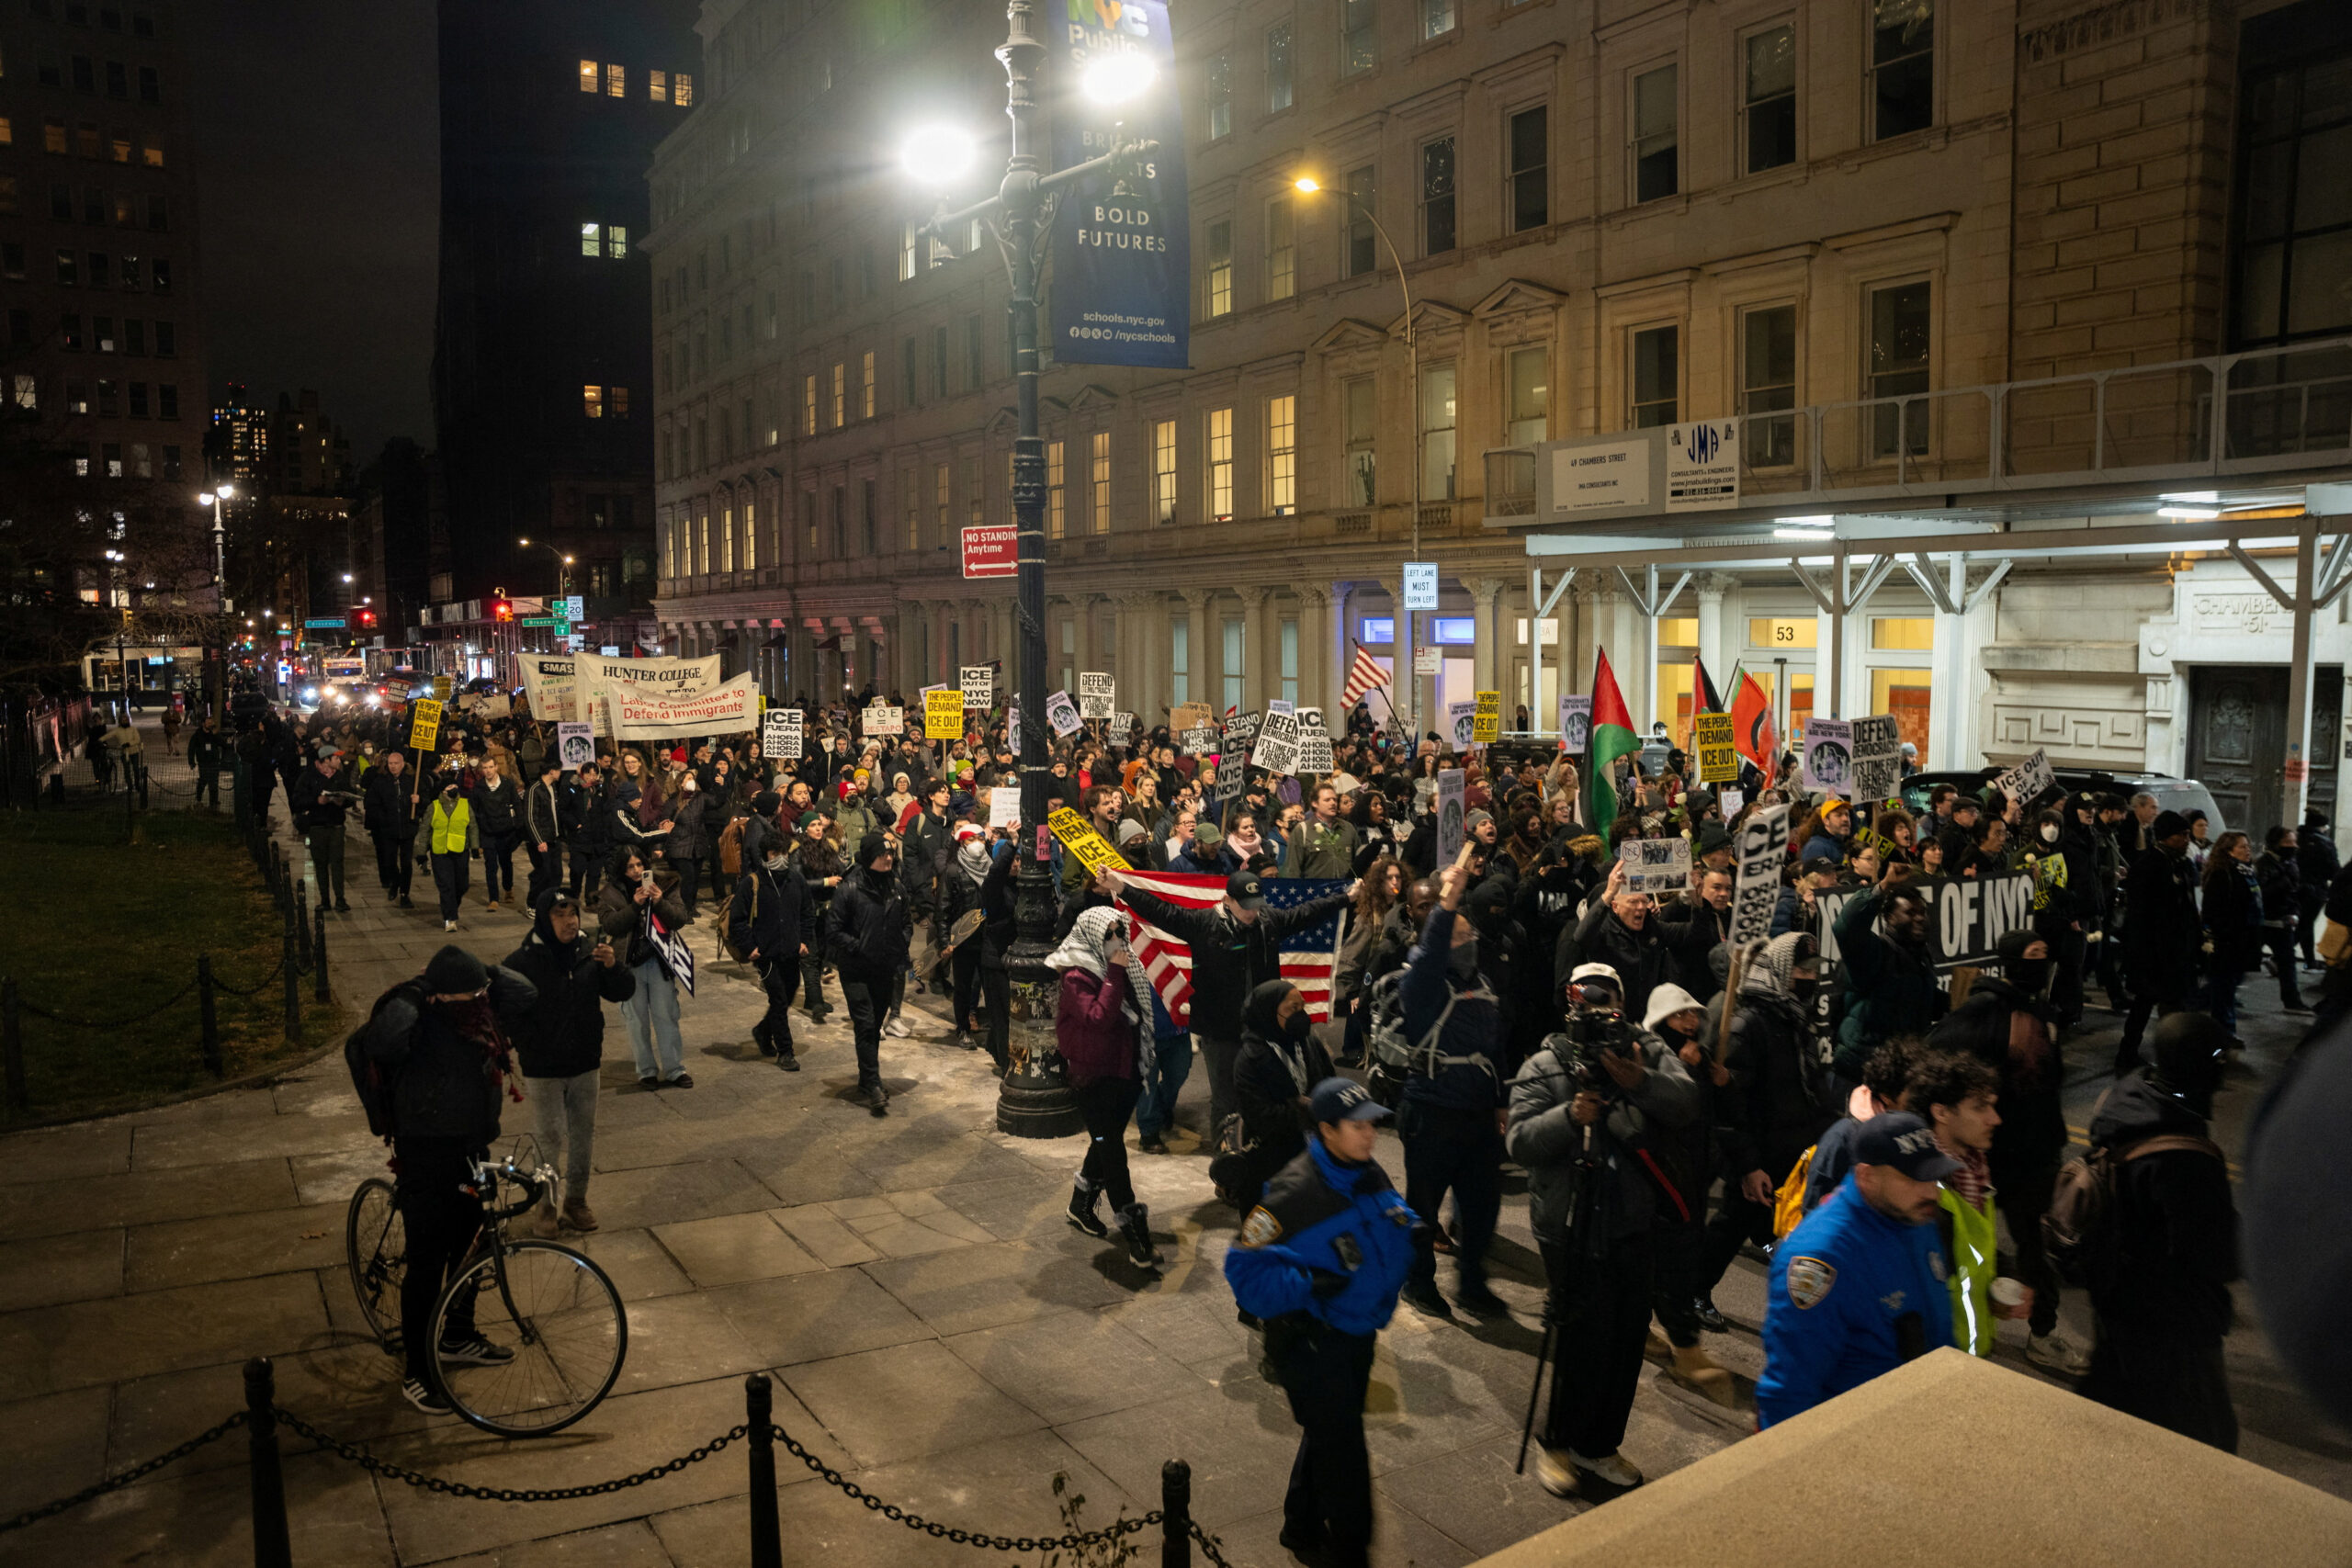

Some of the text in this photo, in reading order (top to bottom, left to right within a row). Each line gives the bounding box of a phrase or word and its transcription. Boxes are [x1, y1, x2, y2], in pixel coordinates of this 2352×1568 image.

[1095, 206, 1149, 226] BOLD
[1078, 229, 1166, 252] FUTURES
[1083, 311, 1165, 327] schools.nyc.gov
[1688, 424, 1719, 464] JMA
[1578, 456, 1607, 467] CHAMBERS
[1608, 453, 1626, 463] STREET
[967, 531, 1017, 542] NO STANDIN
[967, 544, 1002, 556] Anytime
[1421, 569, 1434, 577] LANE
[1412, 582, 1430, 591] MUST
[1422, 595, 1435, 604] LEFT
[1776, 627, 1794, 641] 53
[543, 663, 574, 673] SMAS
[603, 665, 701, 682] HUNTER COLLEGE
[962, 670, 990, 680] ICE
[1082, 674, 1113, 687] DEFEND
[620, 694, 654, 708] Labor
[659, 693, 729, 709] Committee
[734, 689, 745, 698] to
[624, 708, 671, 719] Defend
[673, 702, 743, 718] Immigrants
[864, 708, 899, 718] ICE
[928, 702, 961, 712] DEMAND
[1476, 704, 1498, 714] DEMAND
[765, 711, 801, 724] ICE
[928, 716, 961, 727] ICE OUT
[1113, 714, 1131, 728] ICE
[1227, 714, 1260, 731] STAND
[1267, 713, 1297, 736] DEFEN
[1475, 718, 1498, 730] ICE OUT
[1697, 716, 1732, 729] THE PEOPLE
[765, 724, 800, 732] FUERA
[1182, 729, 1213, 739] KRISTI
[1811, 722, 1849, 732] IMMIGRANTS
[1853, 716, 1897, 744] DEFEND
[1700, 728, 1734, 745] DEMAND
[1183, 743, 1216, 754] MORE
[1223, 736, 1246, 755] ICE
[1259, 739, 1272, 749] IT'S
[1272, 742, 1287, 753] TIME
[1260, 748, 1294, 765] A GENERAL
[1702, 749, 1735, 766] ICE OUT
[1261, 758, 1287, 773] STRIKE!
[1865, 759, 1884, 773] TIME
[1886, 757, 1900, 770] FOR
[2000, 750, 2044, 790] ICE OUT
[1219, 766, 1242, 784] NYC
[1217, 781, 1240, 796] NOW
[2015, 779, 2028, 793] OF
[1049, 814, 1069, 829] THE
[1745, 812, 1786, 858] CE
[1074, 840, 1105, 863] ICE
[1940, 881, 1979, 957] OF
[1984, 874, 2034, 953] NYC
